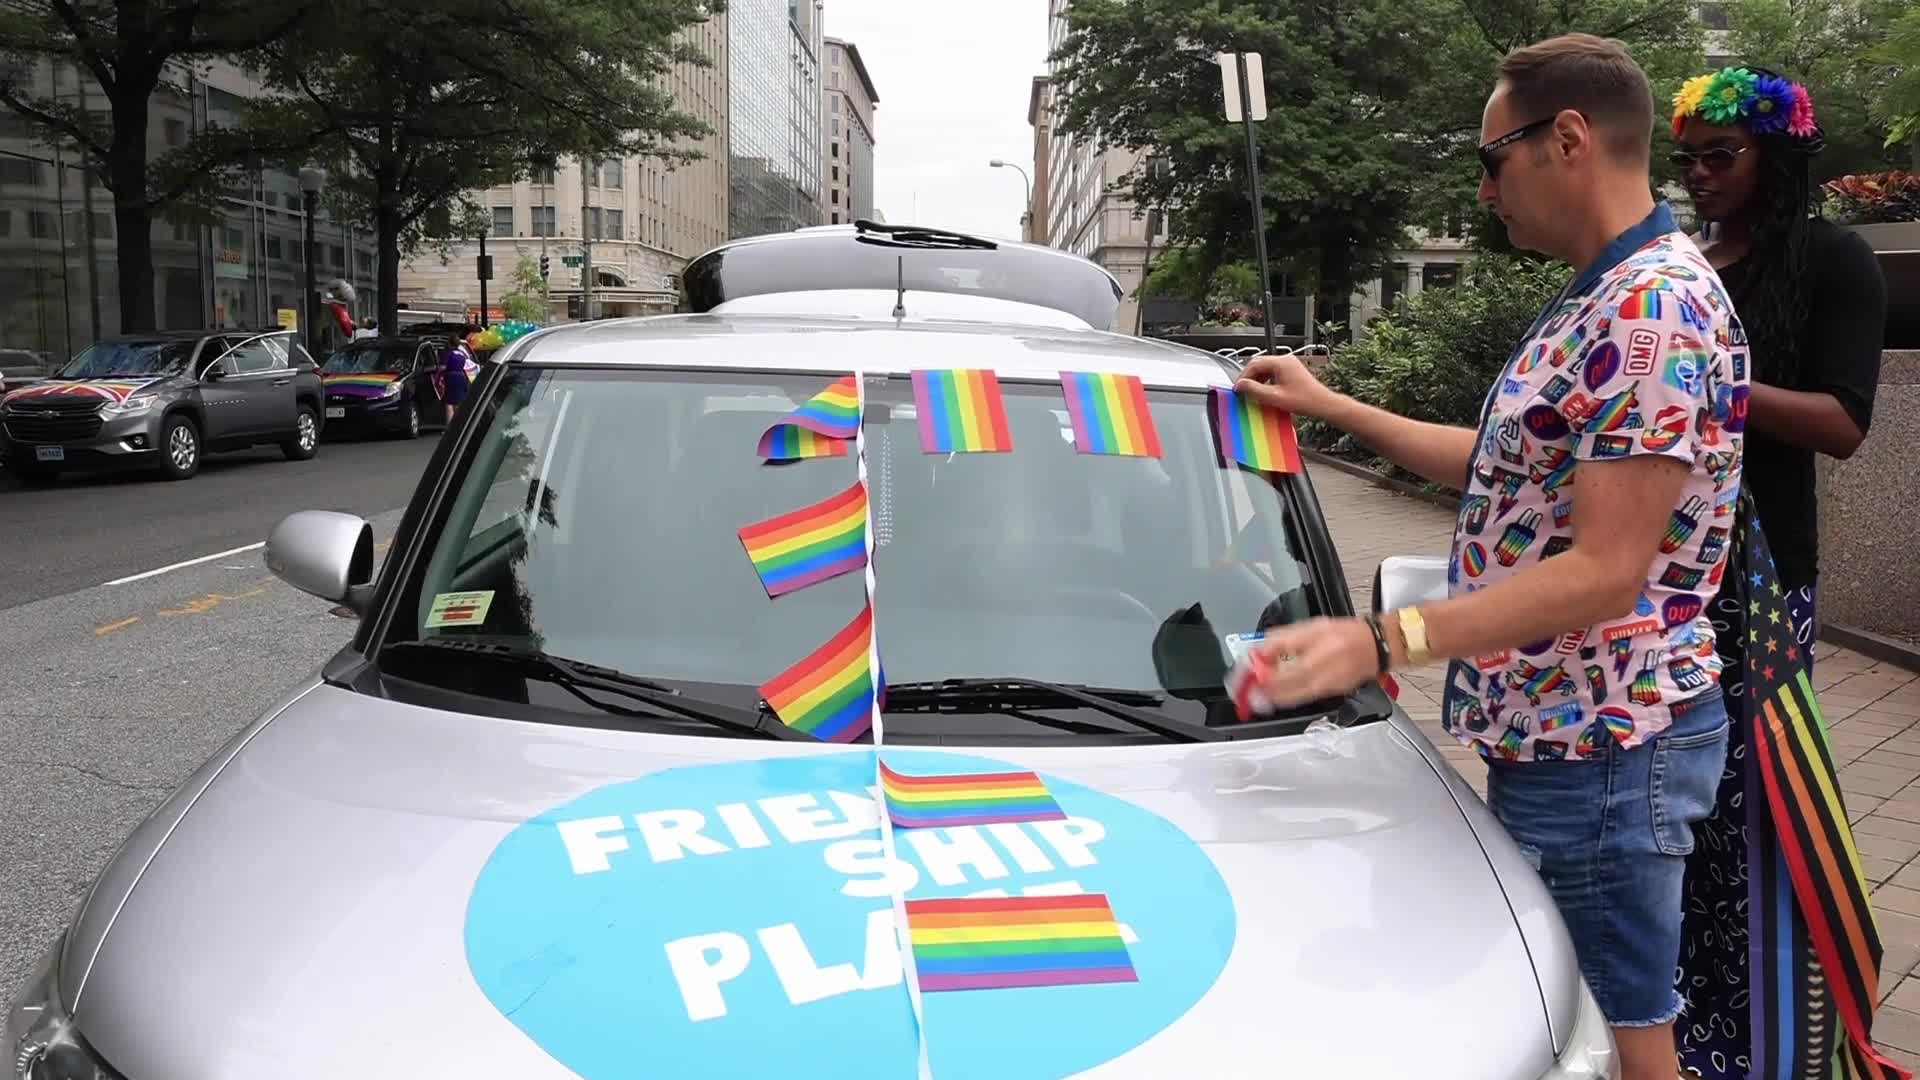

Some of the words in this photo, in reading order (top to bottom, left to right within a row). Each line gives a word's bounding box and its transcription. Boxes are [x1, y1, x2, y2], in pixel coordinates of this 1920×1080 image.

[1629, 334, 1655, 370] OMG
[1668, 604, 1699, 621] OUT
[556, 785, 884, 875] FRIEN
[824, 816, 1106, 897] SHIP
